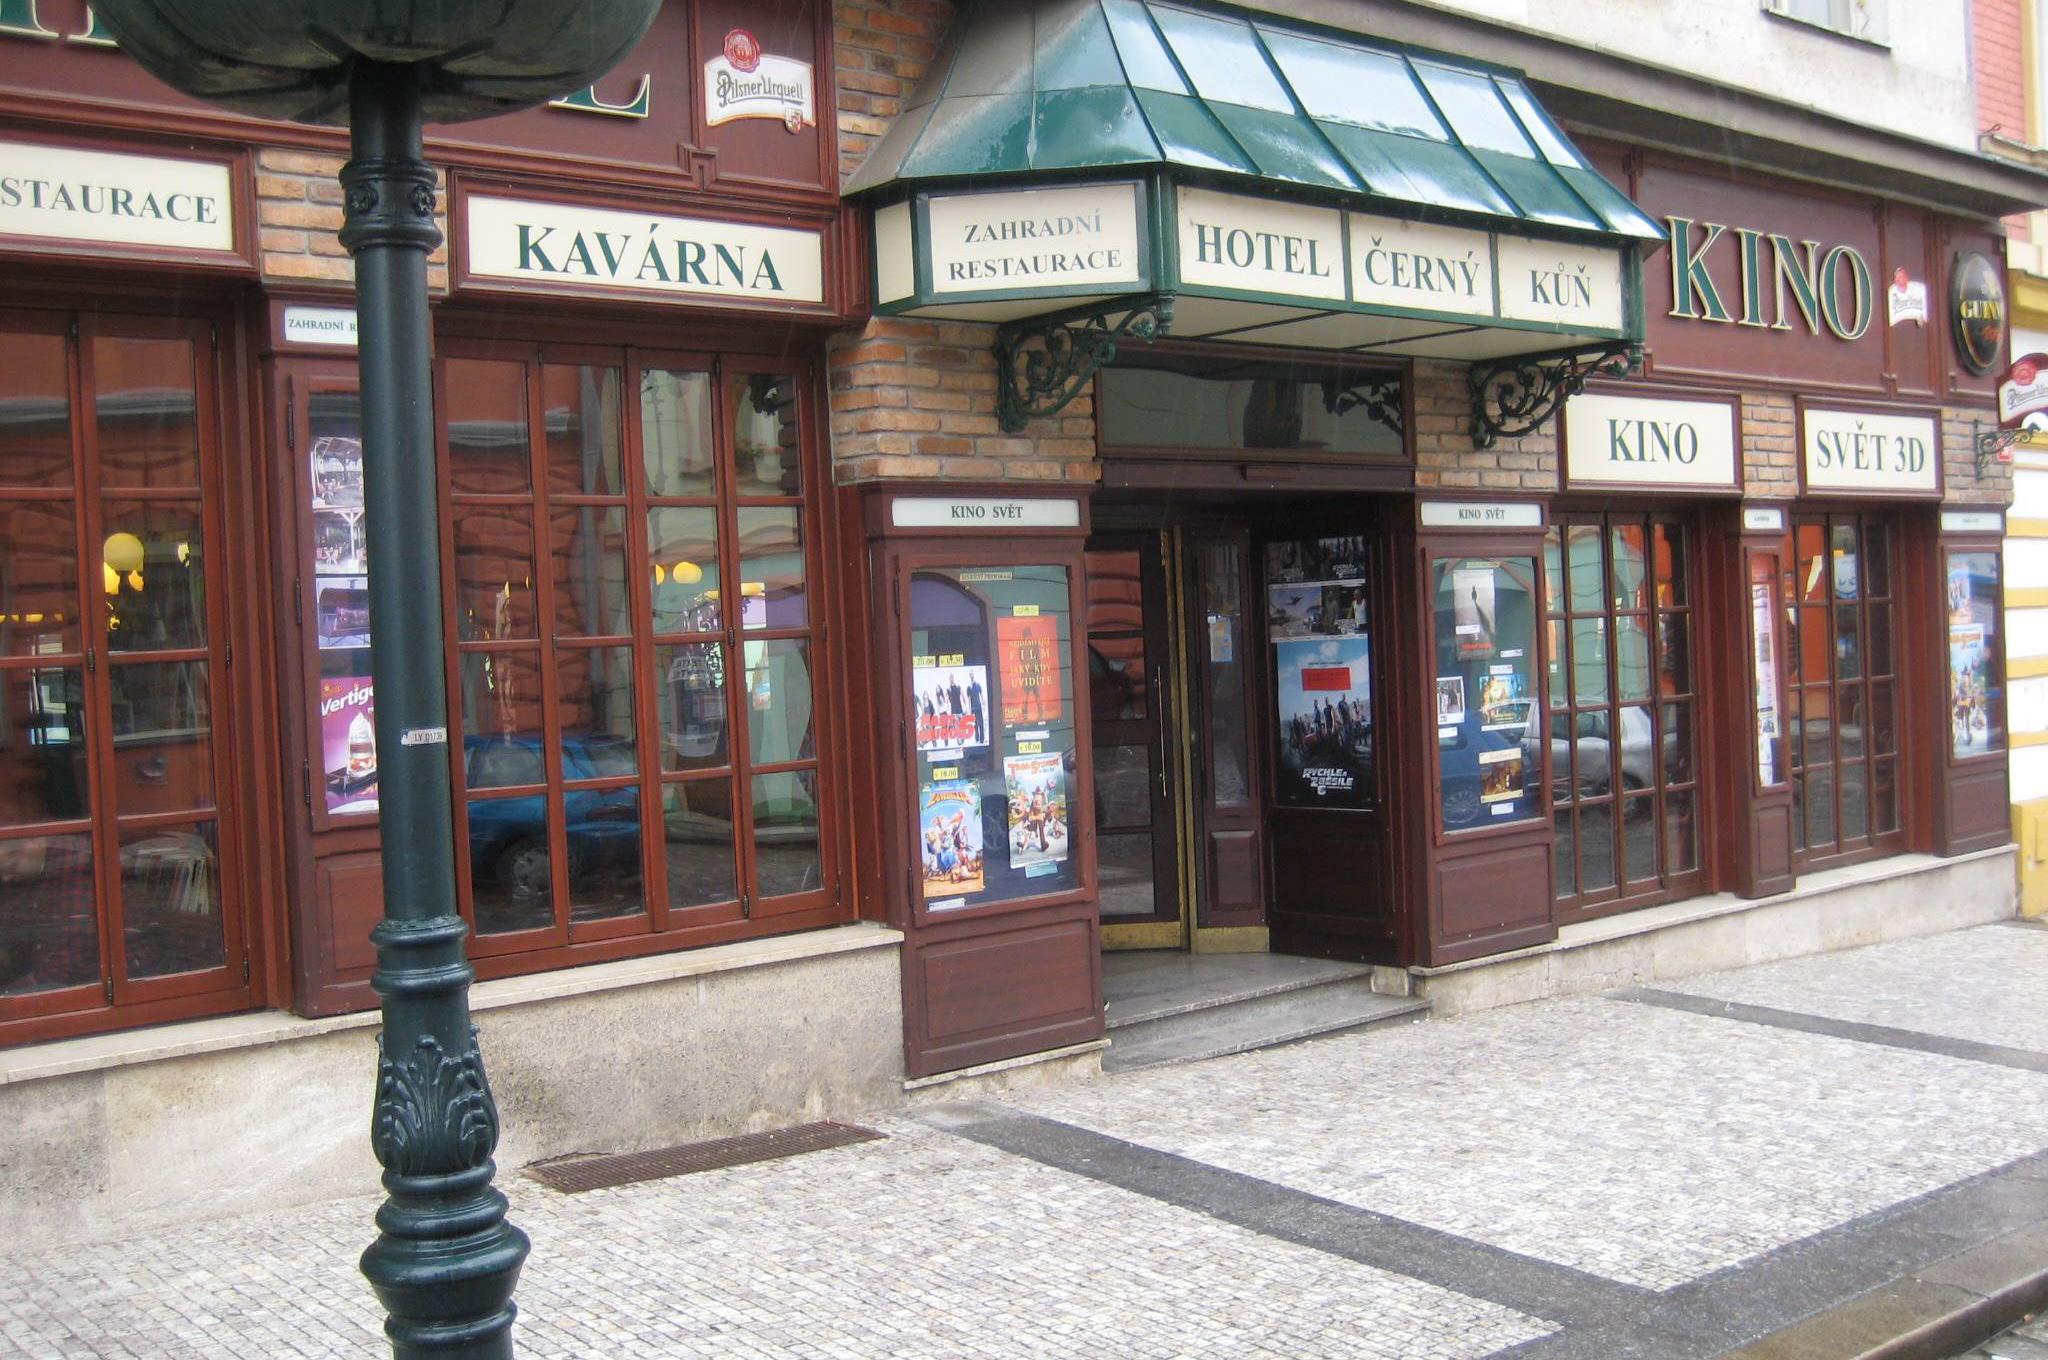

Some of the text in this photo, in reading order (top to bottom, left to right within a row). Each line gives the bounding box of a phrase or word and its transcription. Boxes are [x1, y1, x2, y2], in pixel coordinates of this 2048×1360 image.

[716, 69, 803, 108] Pilsner Urquell
[0, 176, 218, 224] STAURACE
[964, 208, 1102, 243] ZAHRADNÍ
[514, 223, 784, 291] KAVÁRNA
[949, 249, 1122, 281] RESTAURACE
[1194, 223, 1592, 308] HOTEL ČERNÝ KŮŇ
[1664, 215, 1872, 341] KINO
[288, 319, 344, 331] ZAHRADNÍ
[1608, 418, 1698, 464] KINO
[1816, 420, 1925, 473] SVĚT 3D
[951, 503, 1024, 518] KINO SVĚT
[1458, 507, 1505, 520] KINO SVĚT
